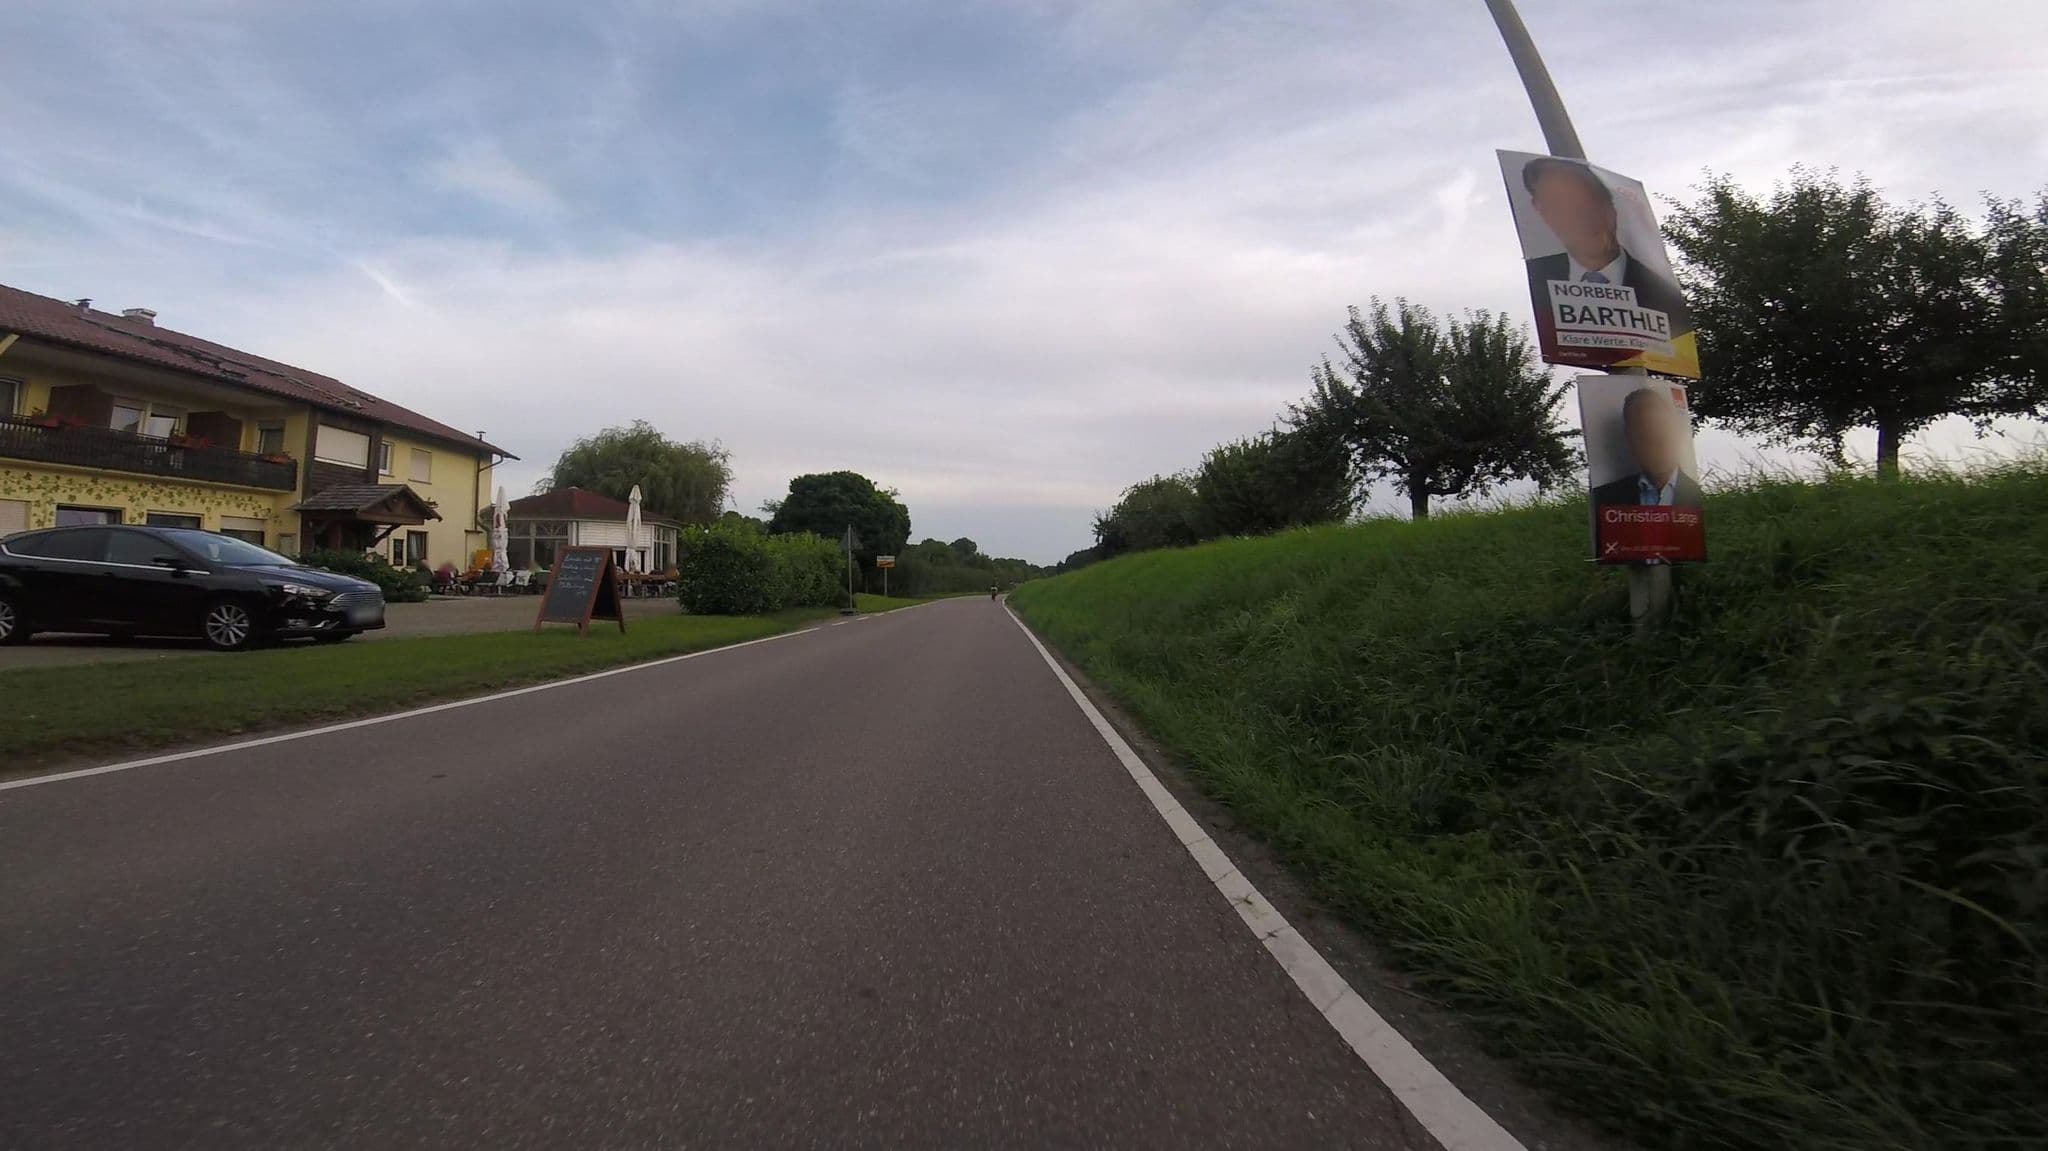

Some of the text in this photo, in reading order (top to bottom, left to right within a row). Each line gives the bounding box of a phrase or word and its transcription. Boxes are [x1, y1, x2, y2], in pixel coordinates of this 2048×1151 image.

[1554, 284, 1630, 301] NORBERT
[1558, 304, 1667, 335] BARTHLE
[1562, 334, 1591, 345] Klare
[1605, 509, 1669, 523] Christian
